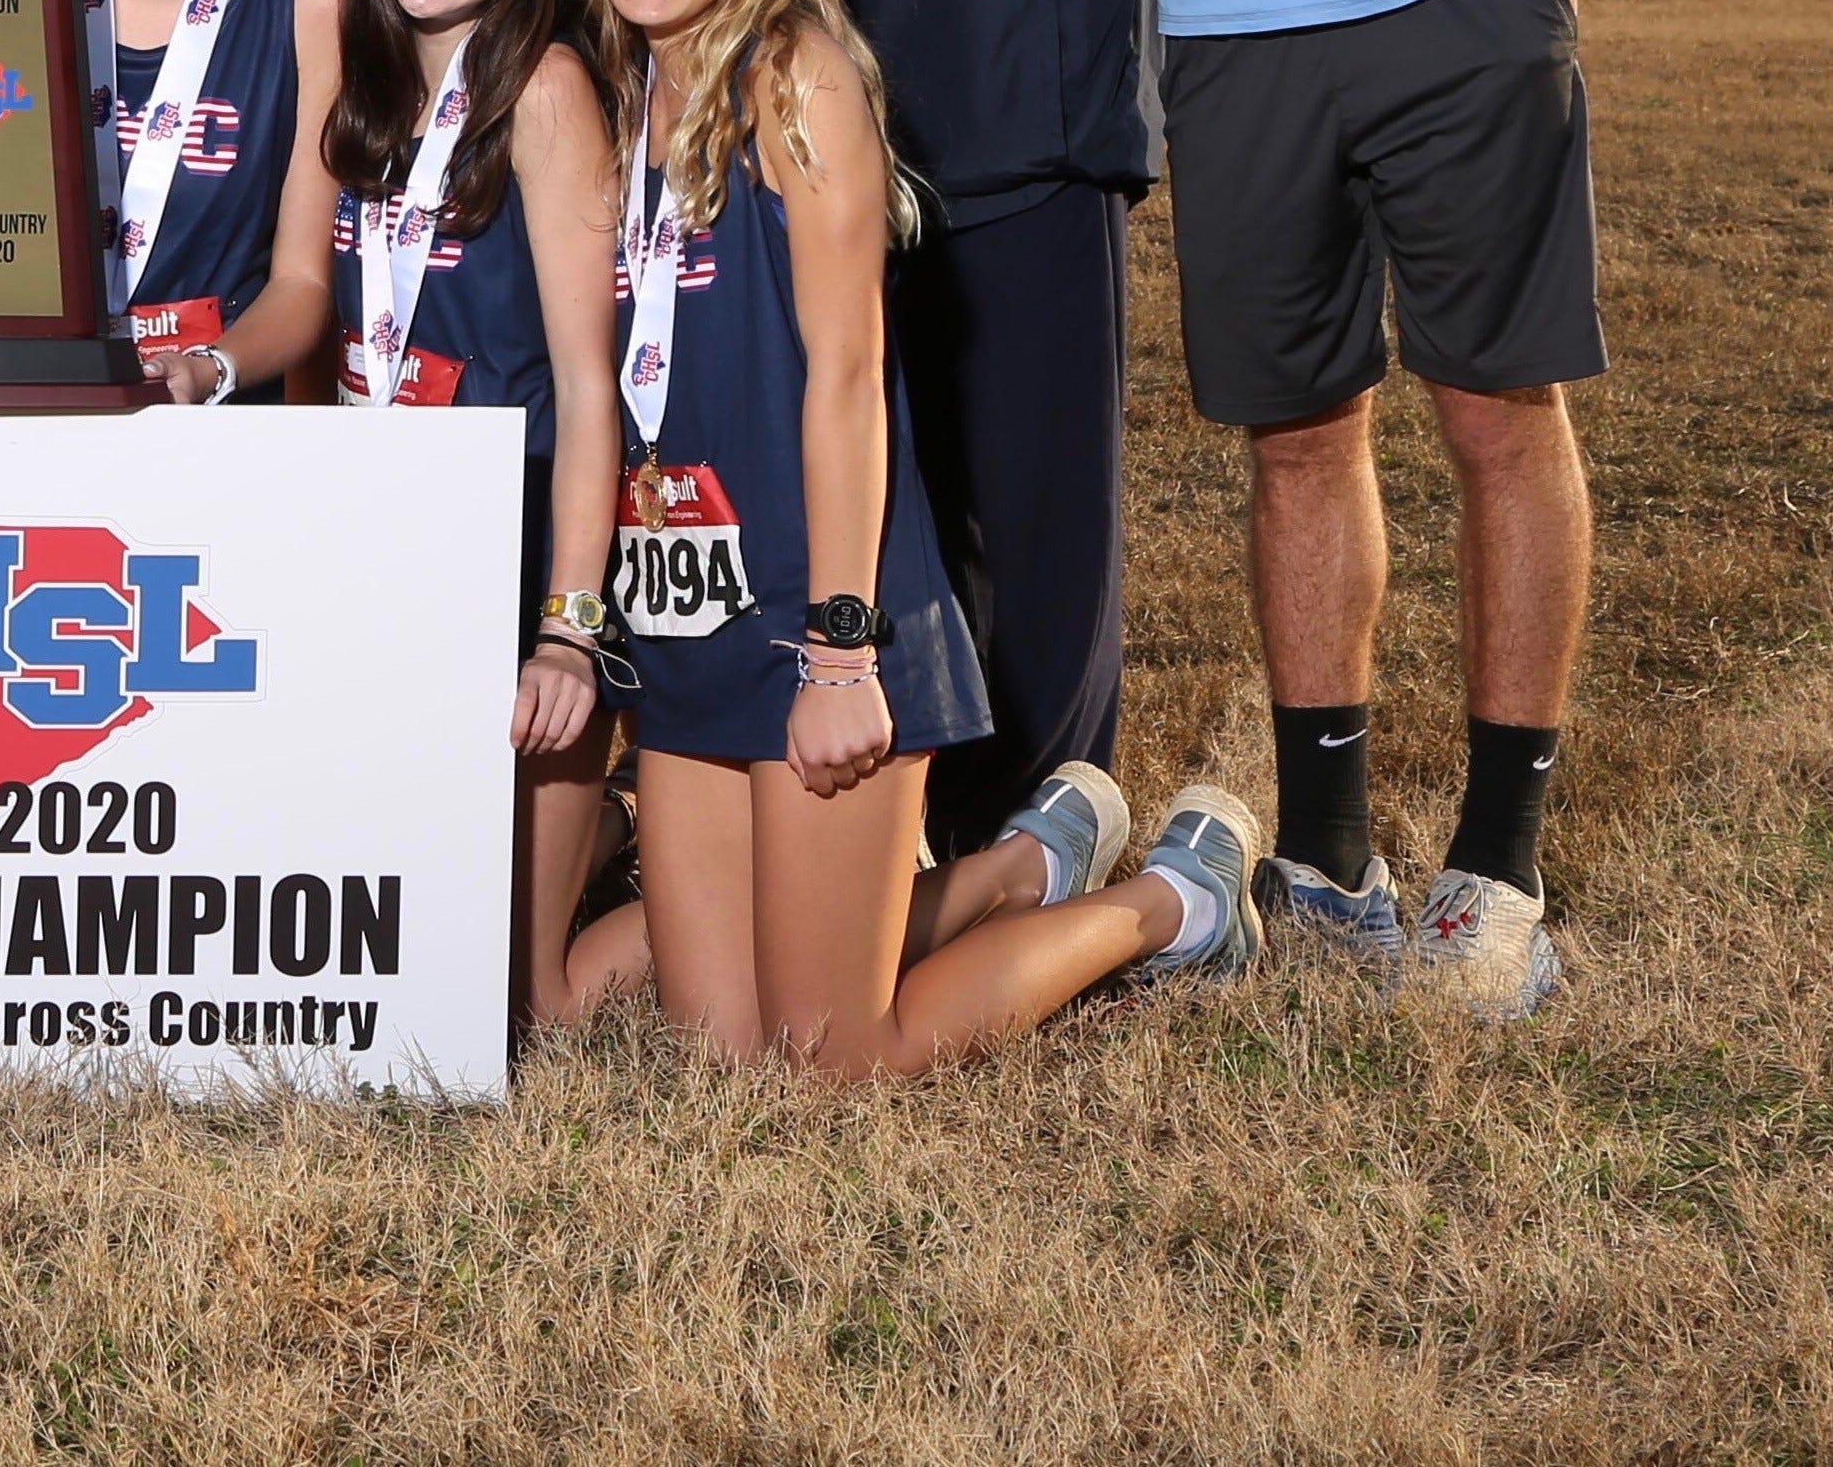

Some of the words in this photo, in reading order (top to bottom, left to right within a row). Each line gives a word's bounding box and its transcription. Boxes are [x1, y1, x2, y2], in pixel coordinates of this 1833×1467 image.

[399, 209, 426, 247] SCHS
[624, 537, 742, 616] 1094
[149, 991, 379, 1051] Country
